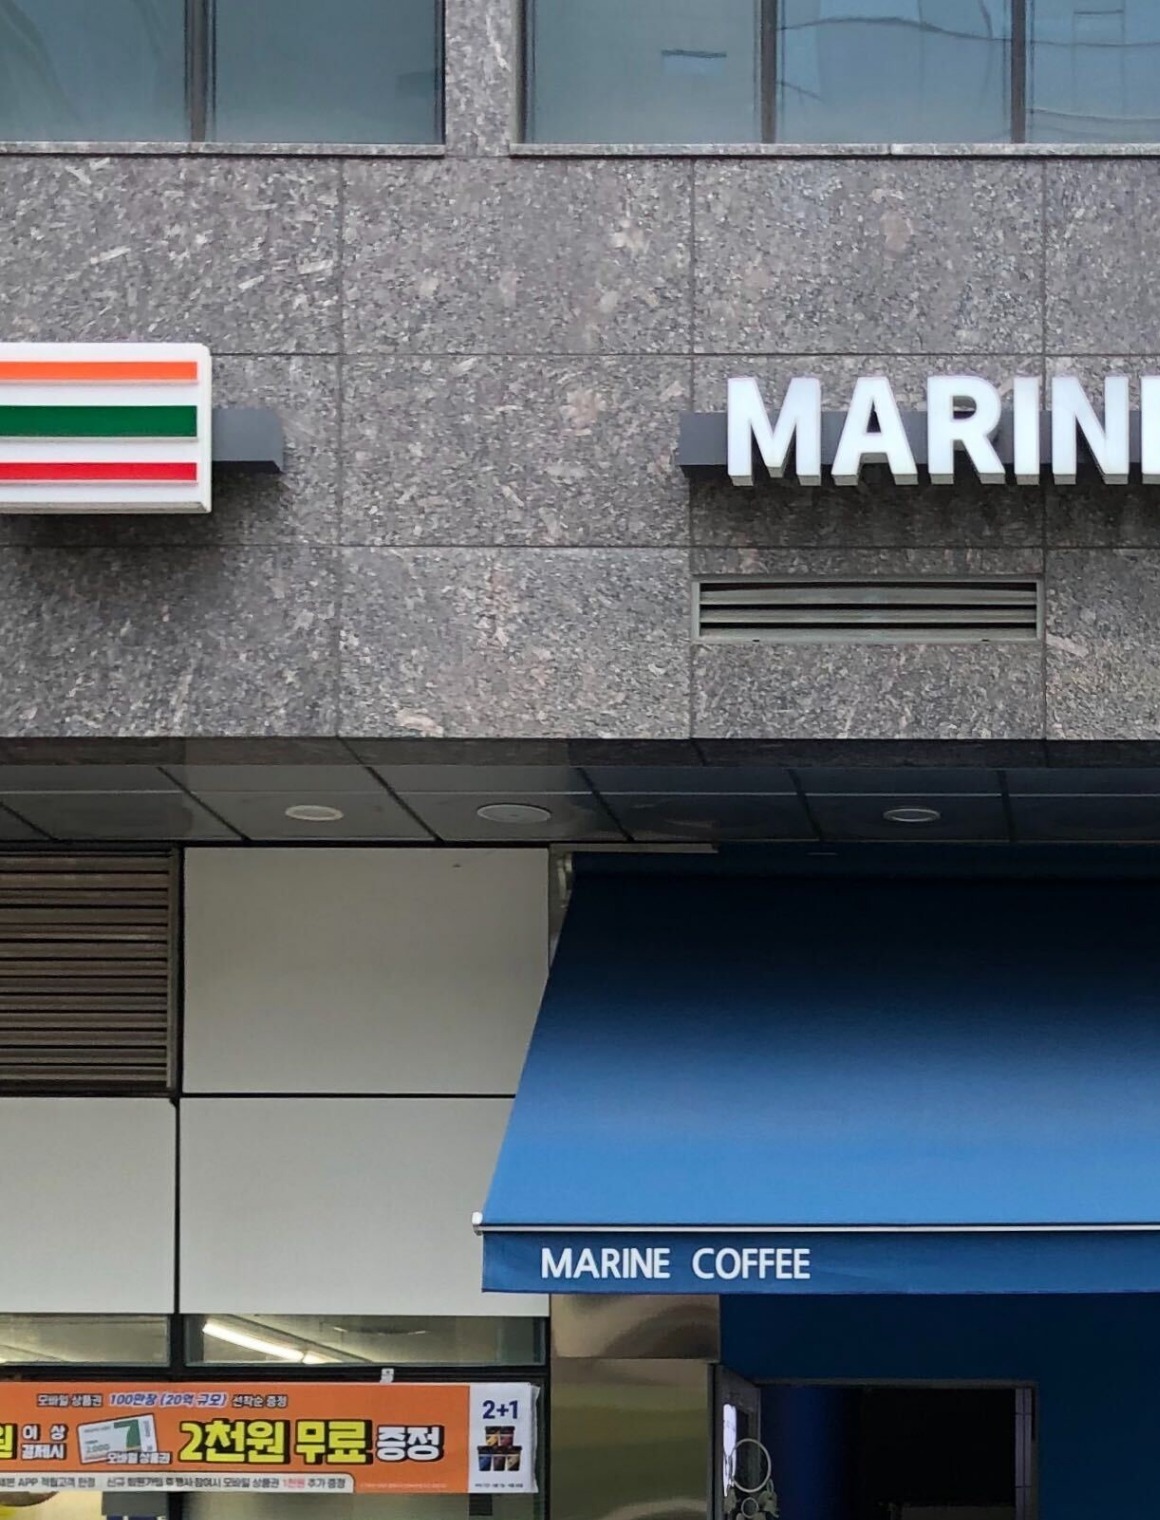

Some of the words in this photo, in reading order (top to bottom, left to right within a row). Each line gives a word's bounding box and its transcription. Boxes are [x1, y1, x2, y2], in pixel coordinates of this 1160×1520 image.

[541, 1247, 671, 1279] MARINE
[692, 1247, 811, 1280] COFFEE
[482, 1399, 519, 1419] 2+1
[179, 1420, 285, 1463] 2천원
[296, 1420, 367, 1464] 무료
[376, 1426, 441, 1461] 증정
